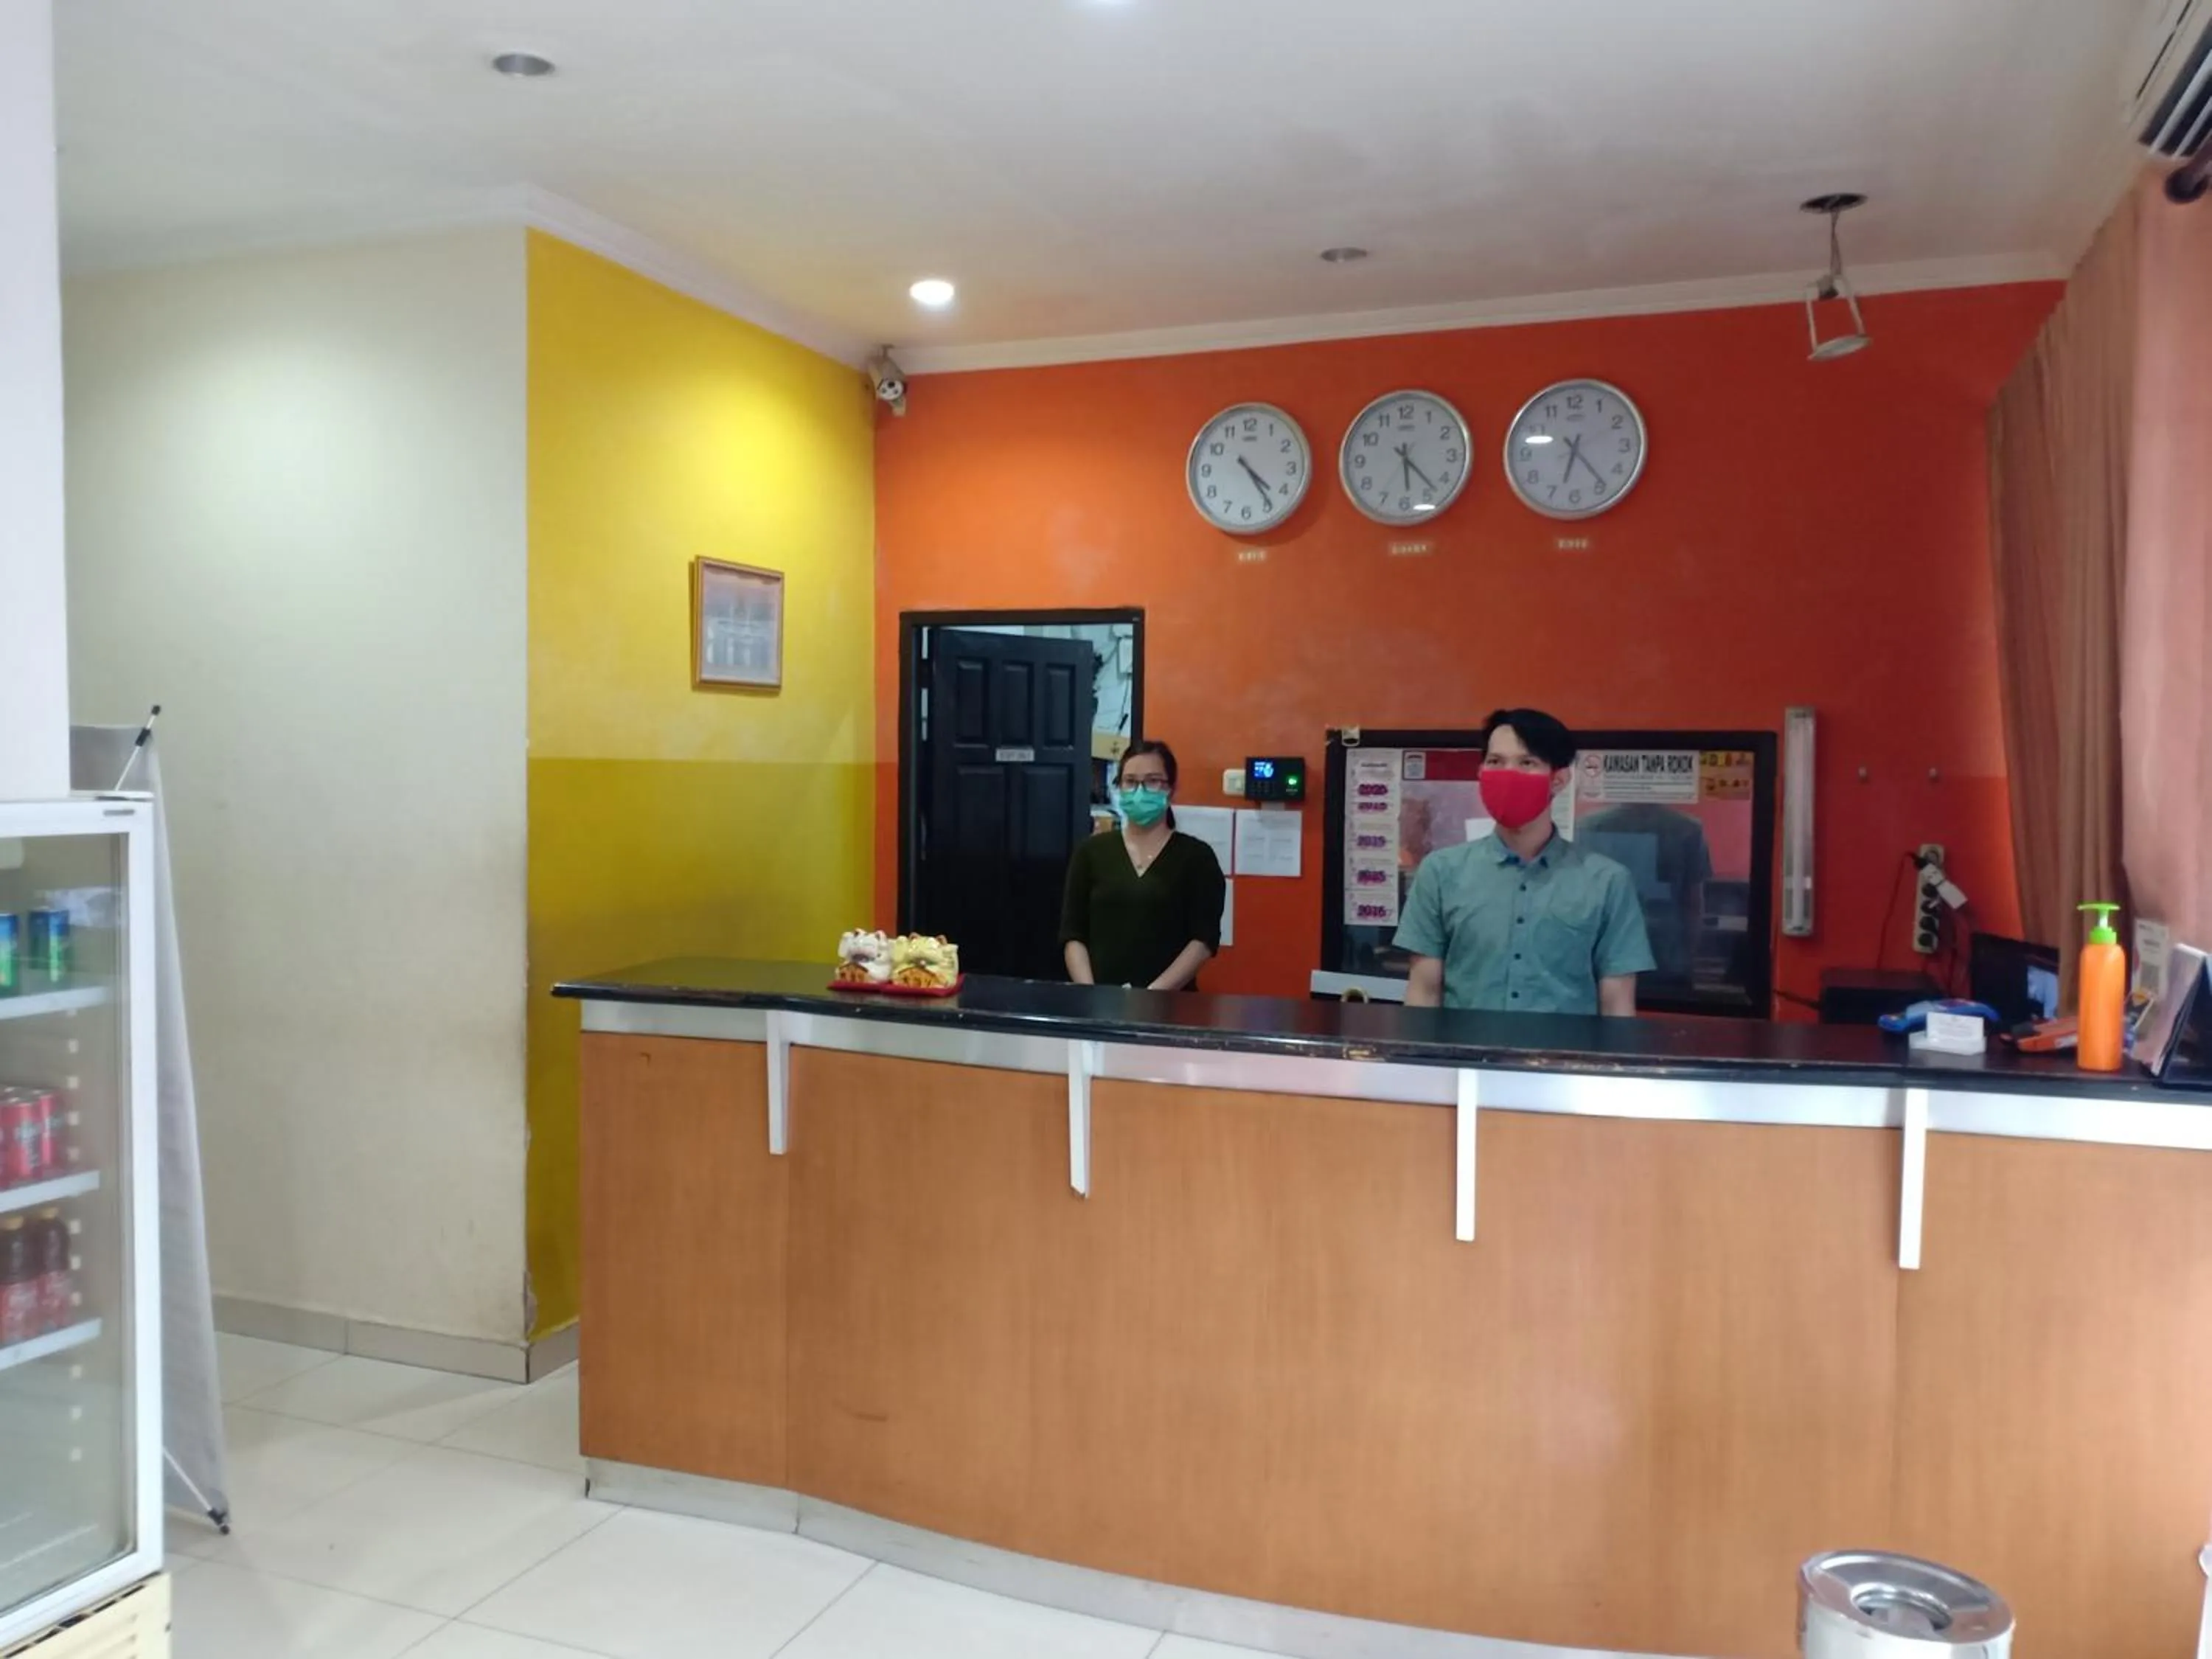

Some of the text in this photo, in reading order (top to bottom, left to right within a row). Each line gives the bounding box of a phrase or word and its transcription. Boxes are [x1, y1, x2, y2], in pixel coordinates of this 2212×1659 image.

[1566, 394, 1584, 411] 12
[1398, 405, 1414, 420] 12
[1545, 406, 1557, 420] 11
[1243, 417, 1257, 431] 12
[1378, 413, 1390, 428] 11
[1611, 414, 1623, 430] 2
[1225, 425, 1236, 439] 11
[1363, 432, 1379, 446] 10
[1440, 425, 1450, 440] 2
[1210, 442, 1225, 456] 10
[1280, 439, 1291, 453] 2
[1618, 438, 1630, 453] 3
[1354, 454, 1366, 468] 9
[1446, 448, 1458, 463] 3
[1201, 464, 1212, 478] 9
[1286, 462, 1297, 476] 3
[1611, 462, 1623, 475] 4
[1360, 476, 1373, 490] 8
[1439, 471, 1450, 484] 4
[1528, 470, 1540, 484] 8
[1206, 485, 1217, 498] 8
[1279, 483, 1289, 495] 4
[1422, 488, 1433, 502] 5
[1546, 485, 1557, 499] 7
[1379, 491, 1389, 505] 7
[1399, 496, 1411, 511] 6
[1568, 490, 1581, 504] 6
[1223, 500, 1233, 514] 7
[1241, 506, 1252, 520] 6
[1604, 754, 1639, 773] KAWASAN
[1641, 754, 1665, 772] TANPA
[1667, 754, 1694, 772] ROKOK
